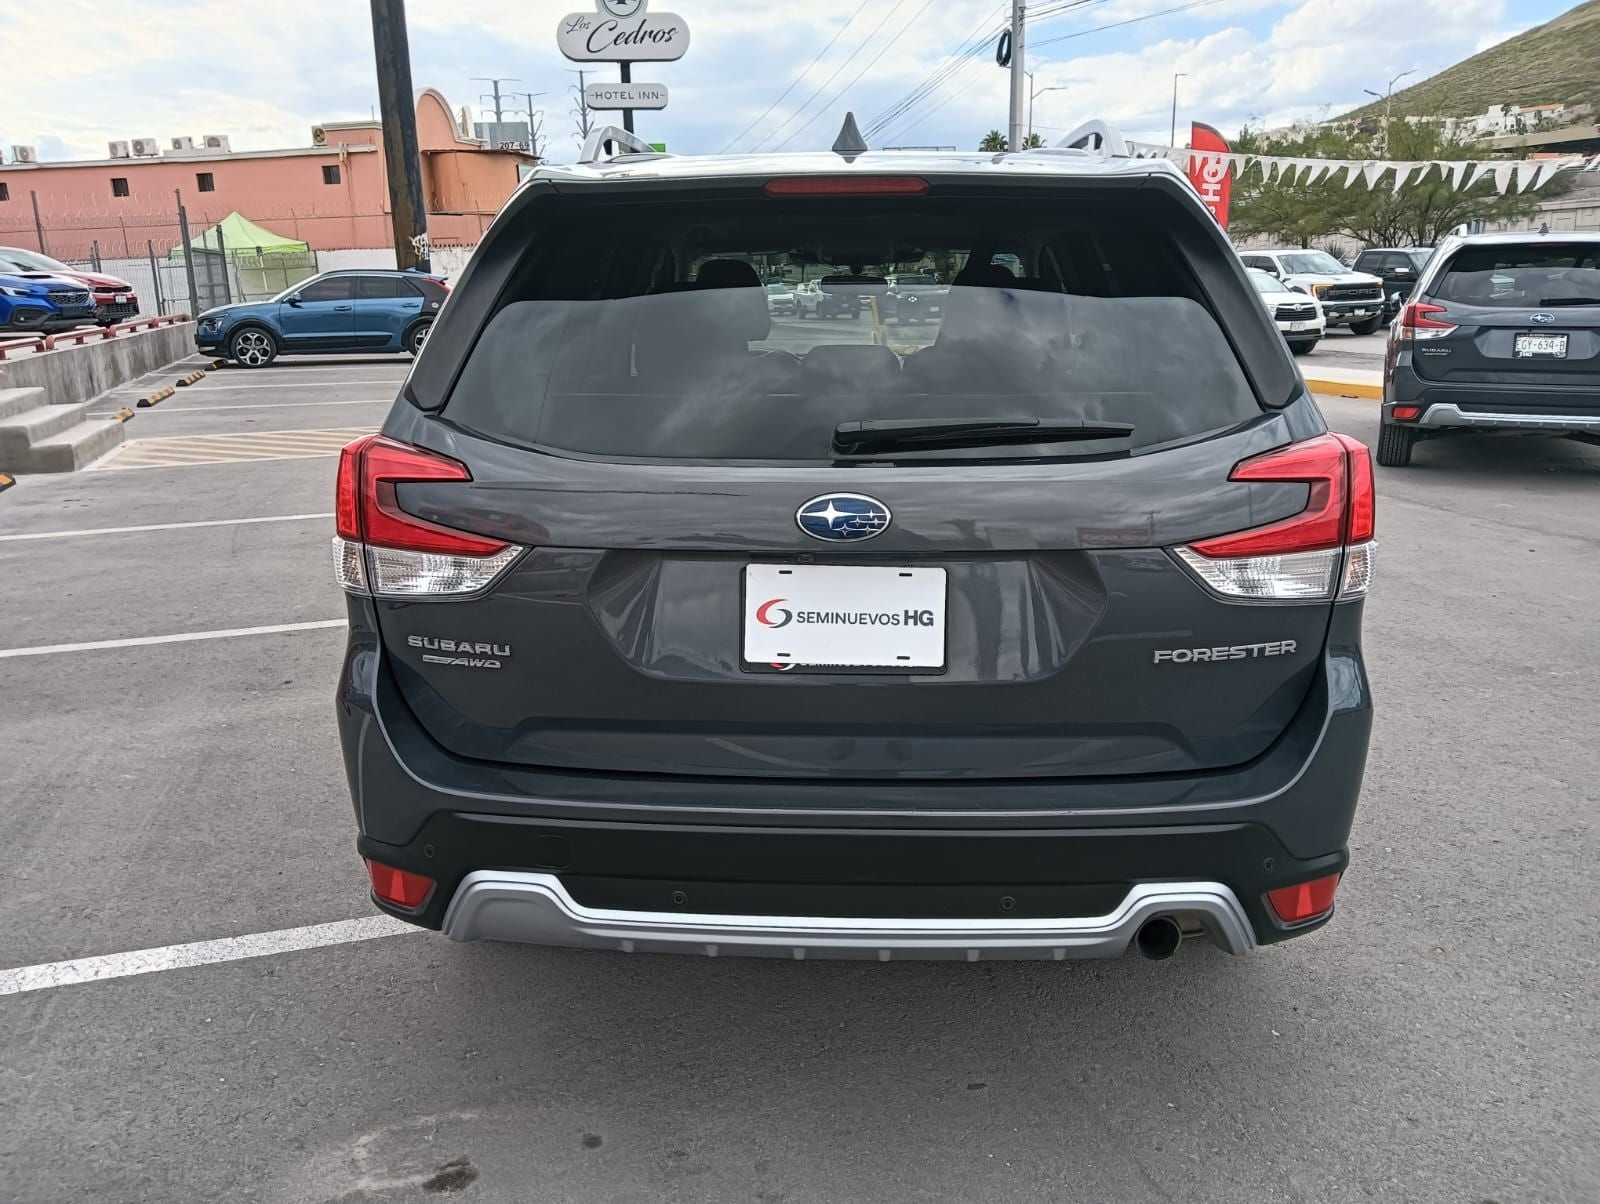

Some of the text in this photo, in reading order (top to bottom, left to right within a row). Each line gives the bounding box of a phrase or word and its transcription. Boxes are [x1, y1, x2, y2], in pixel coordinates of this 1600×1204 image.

[566, 16, 679, 53] Los Cedros
[595, 91, 659, 100] HOTEL INN
[796, 609, 934, 627] SEMINUEVOS HG
[407, 635, 511, 657] SUBARU
[1153, 639, 1298, 664] FORESTER
